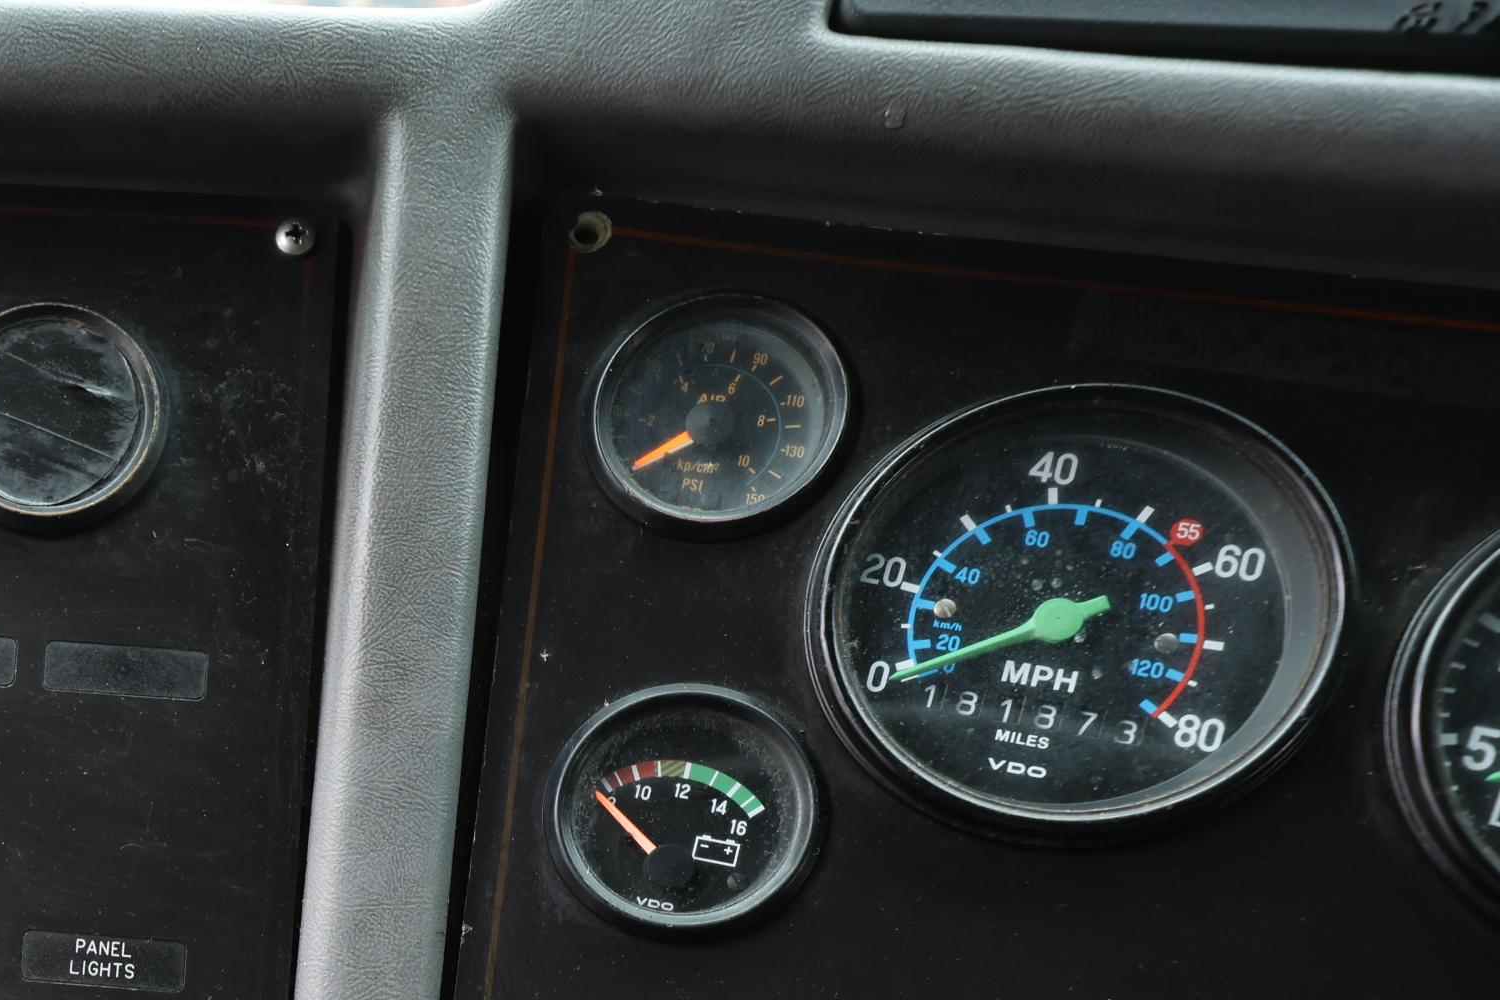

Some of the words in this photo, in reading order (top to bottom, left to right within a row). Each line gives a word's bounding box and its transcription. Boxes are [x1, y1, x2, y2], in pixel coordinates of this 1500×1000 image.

[753, 352, 769, 366] 90
[728, 383, 736, 395] 6
[786, 395, 805, 408] 110
[757, 415, 765, 427] 8
[738, 455, 750, 468] 10
[786, 446, 805, 459] 130
[1029, 452, 1079, 486] 40
[681, 478, 703, 494] PSI
[1024, 530, 1050, 549] 60
[1176, 521, 1202, 542] 55
[1110, 541, 1136, 561] 80
[859, 553, 907, 588] 20
[1214, 544, 1266, 582] 60
[955, 566, 981, 586] 40
[1139, 593, 1174, 613] 100
[933, 619, 962, 631] km/h
[935, 633, 961, 652] 20
[866, 661, 889, 693] 0
[1000, 660, 1079, 694] MPH
[1131, 658, 1164, 680] 120
[995, 729, 1050, 750] MILES
[1174, 713, 1226, 753] 80
[988, 757, 1047, 779] VDO
[634, 784, 652, 801] 10
[674, 783, 691, 800] 12
[710, 799, 727, 815] 14
[730, 819, 748, 836] 16
[636, 895, 674, 912] VDO
[75, 938, 132, 958] PANEL
[69, 960, 136, 979] LIGHTS
